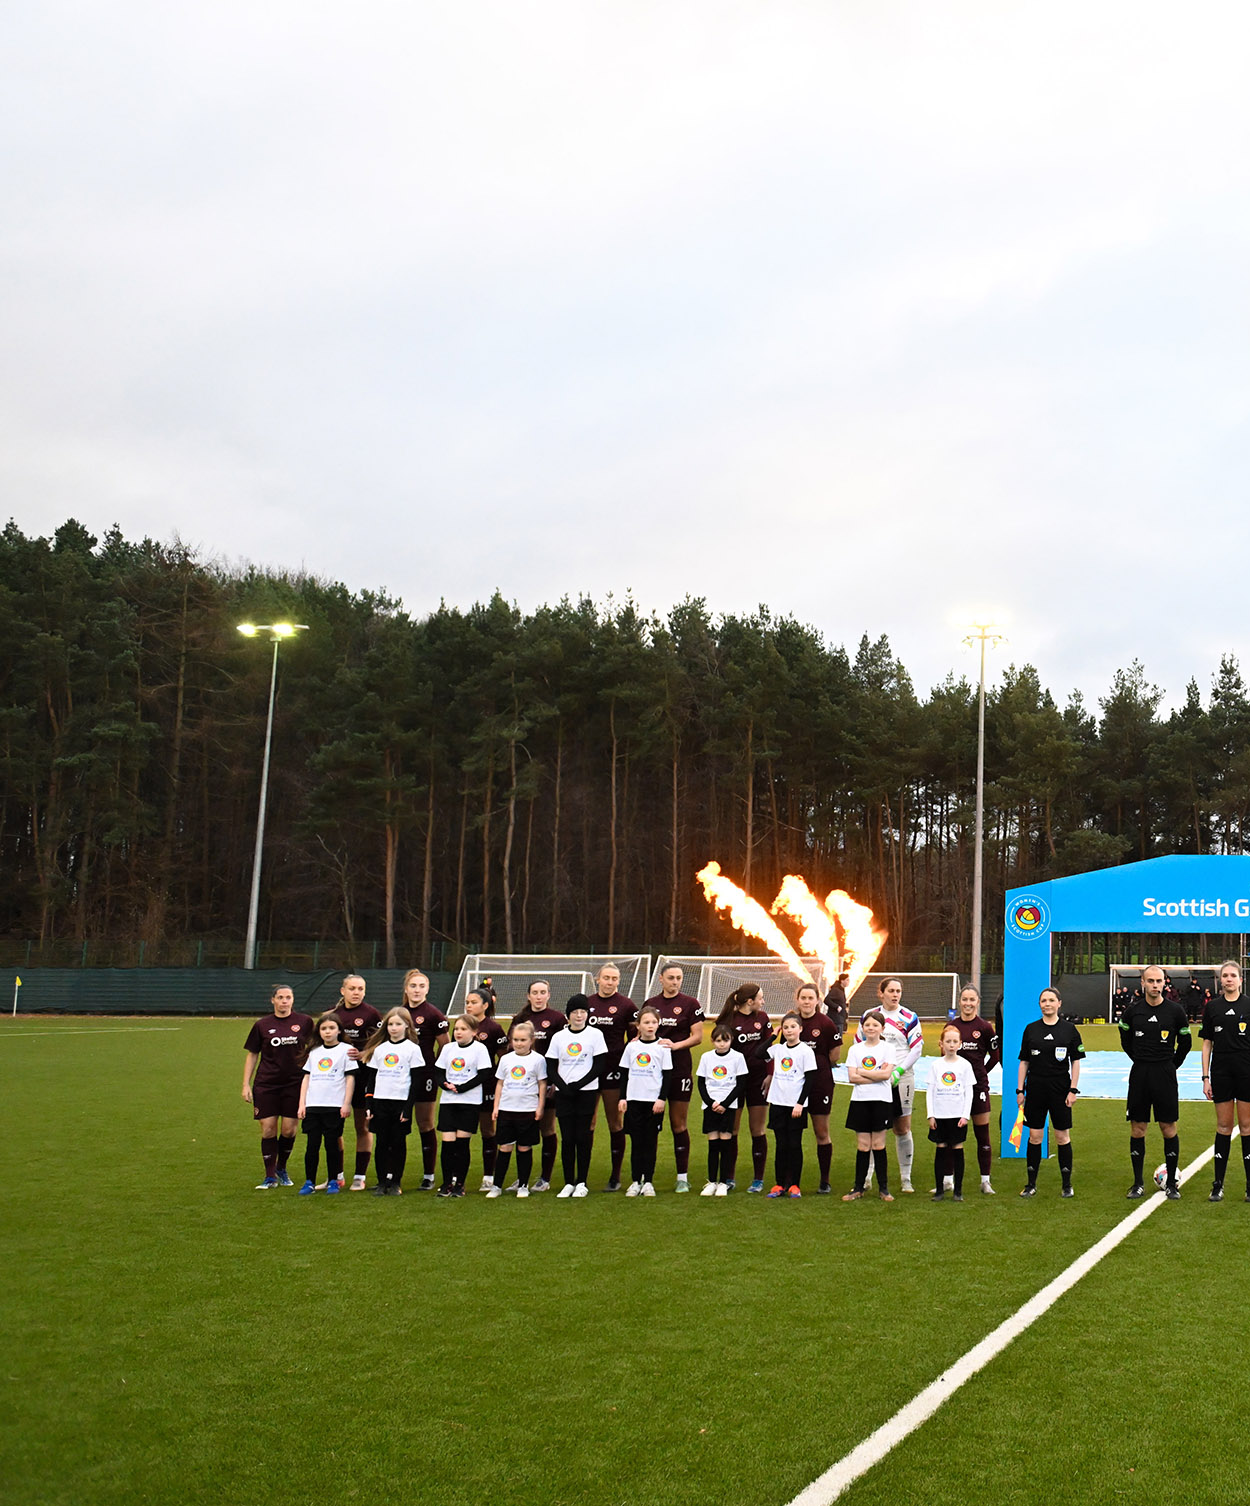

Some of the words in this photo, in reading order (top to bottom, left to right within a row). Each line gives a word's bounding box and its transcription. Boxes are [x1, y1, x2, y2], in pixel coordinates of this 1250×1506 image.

[1143, 898, 1229, 916] Scottish
[425, 1078, 433, 1092] 8
[681, 1078, 692, 1092] 12
[979, 1091, 987, 1102] 4
